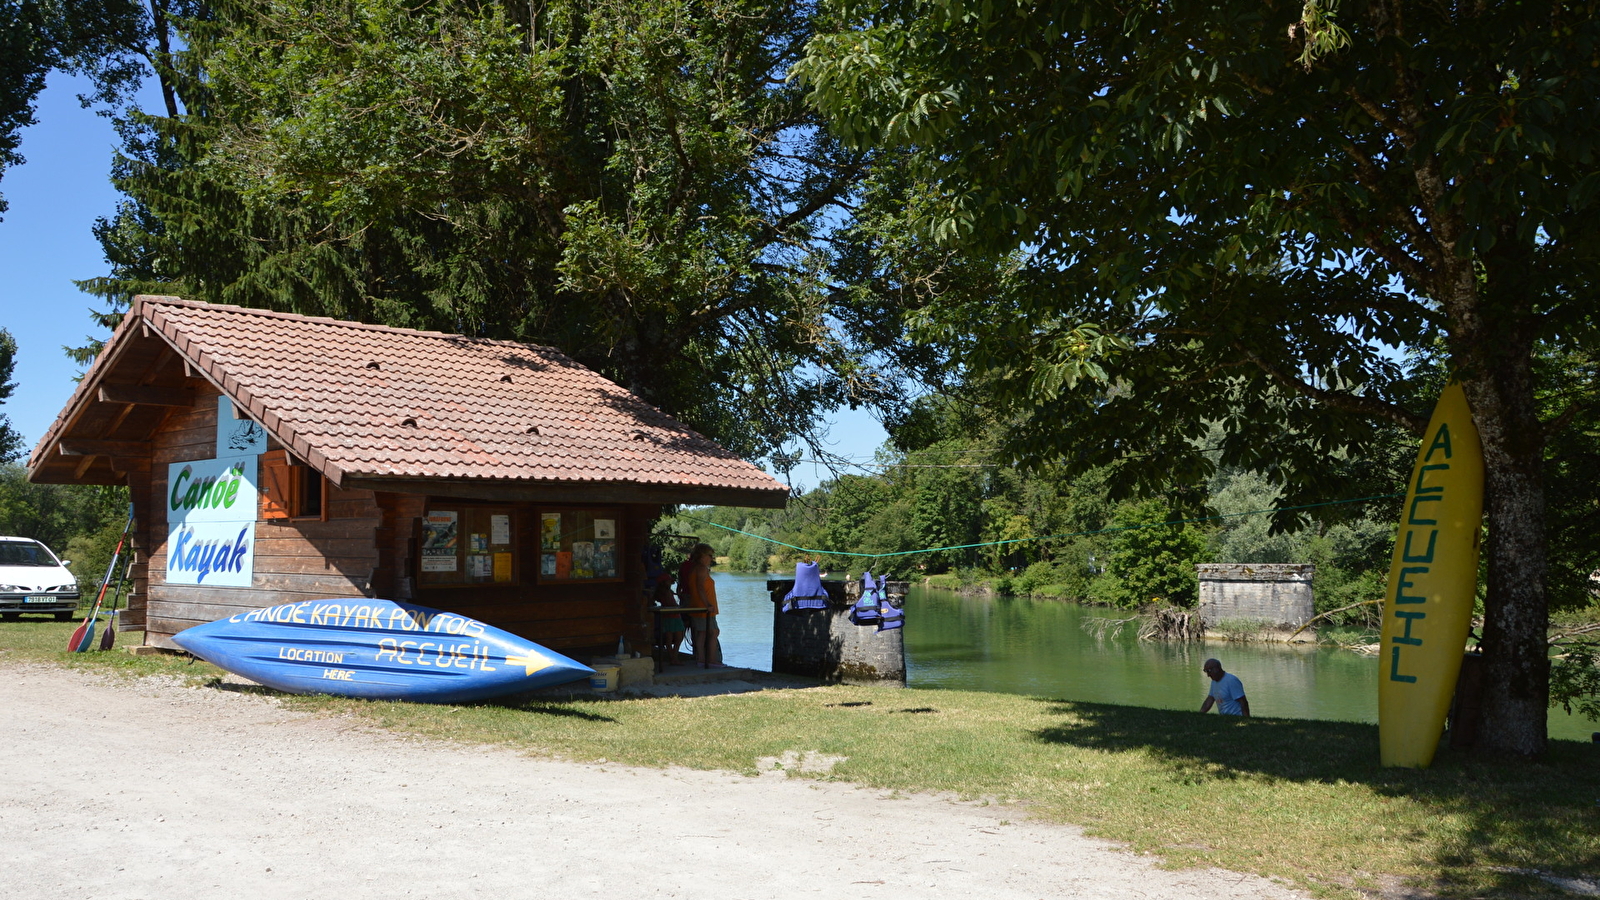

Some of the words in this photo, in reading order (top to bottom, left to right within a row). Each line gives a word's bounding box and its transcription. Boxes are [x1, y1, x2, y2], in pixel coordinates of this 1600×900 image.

[170, 462, 245, 512] Canoë
[169, 524, 249, 584] Kayak
[1390, 423, 1453, 684] ACCUEIL
[310, 604, 386, 630] KAYAK
[279, 647, 344, 664] LOCATION
[322, 669, 356, 681] HERE
